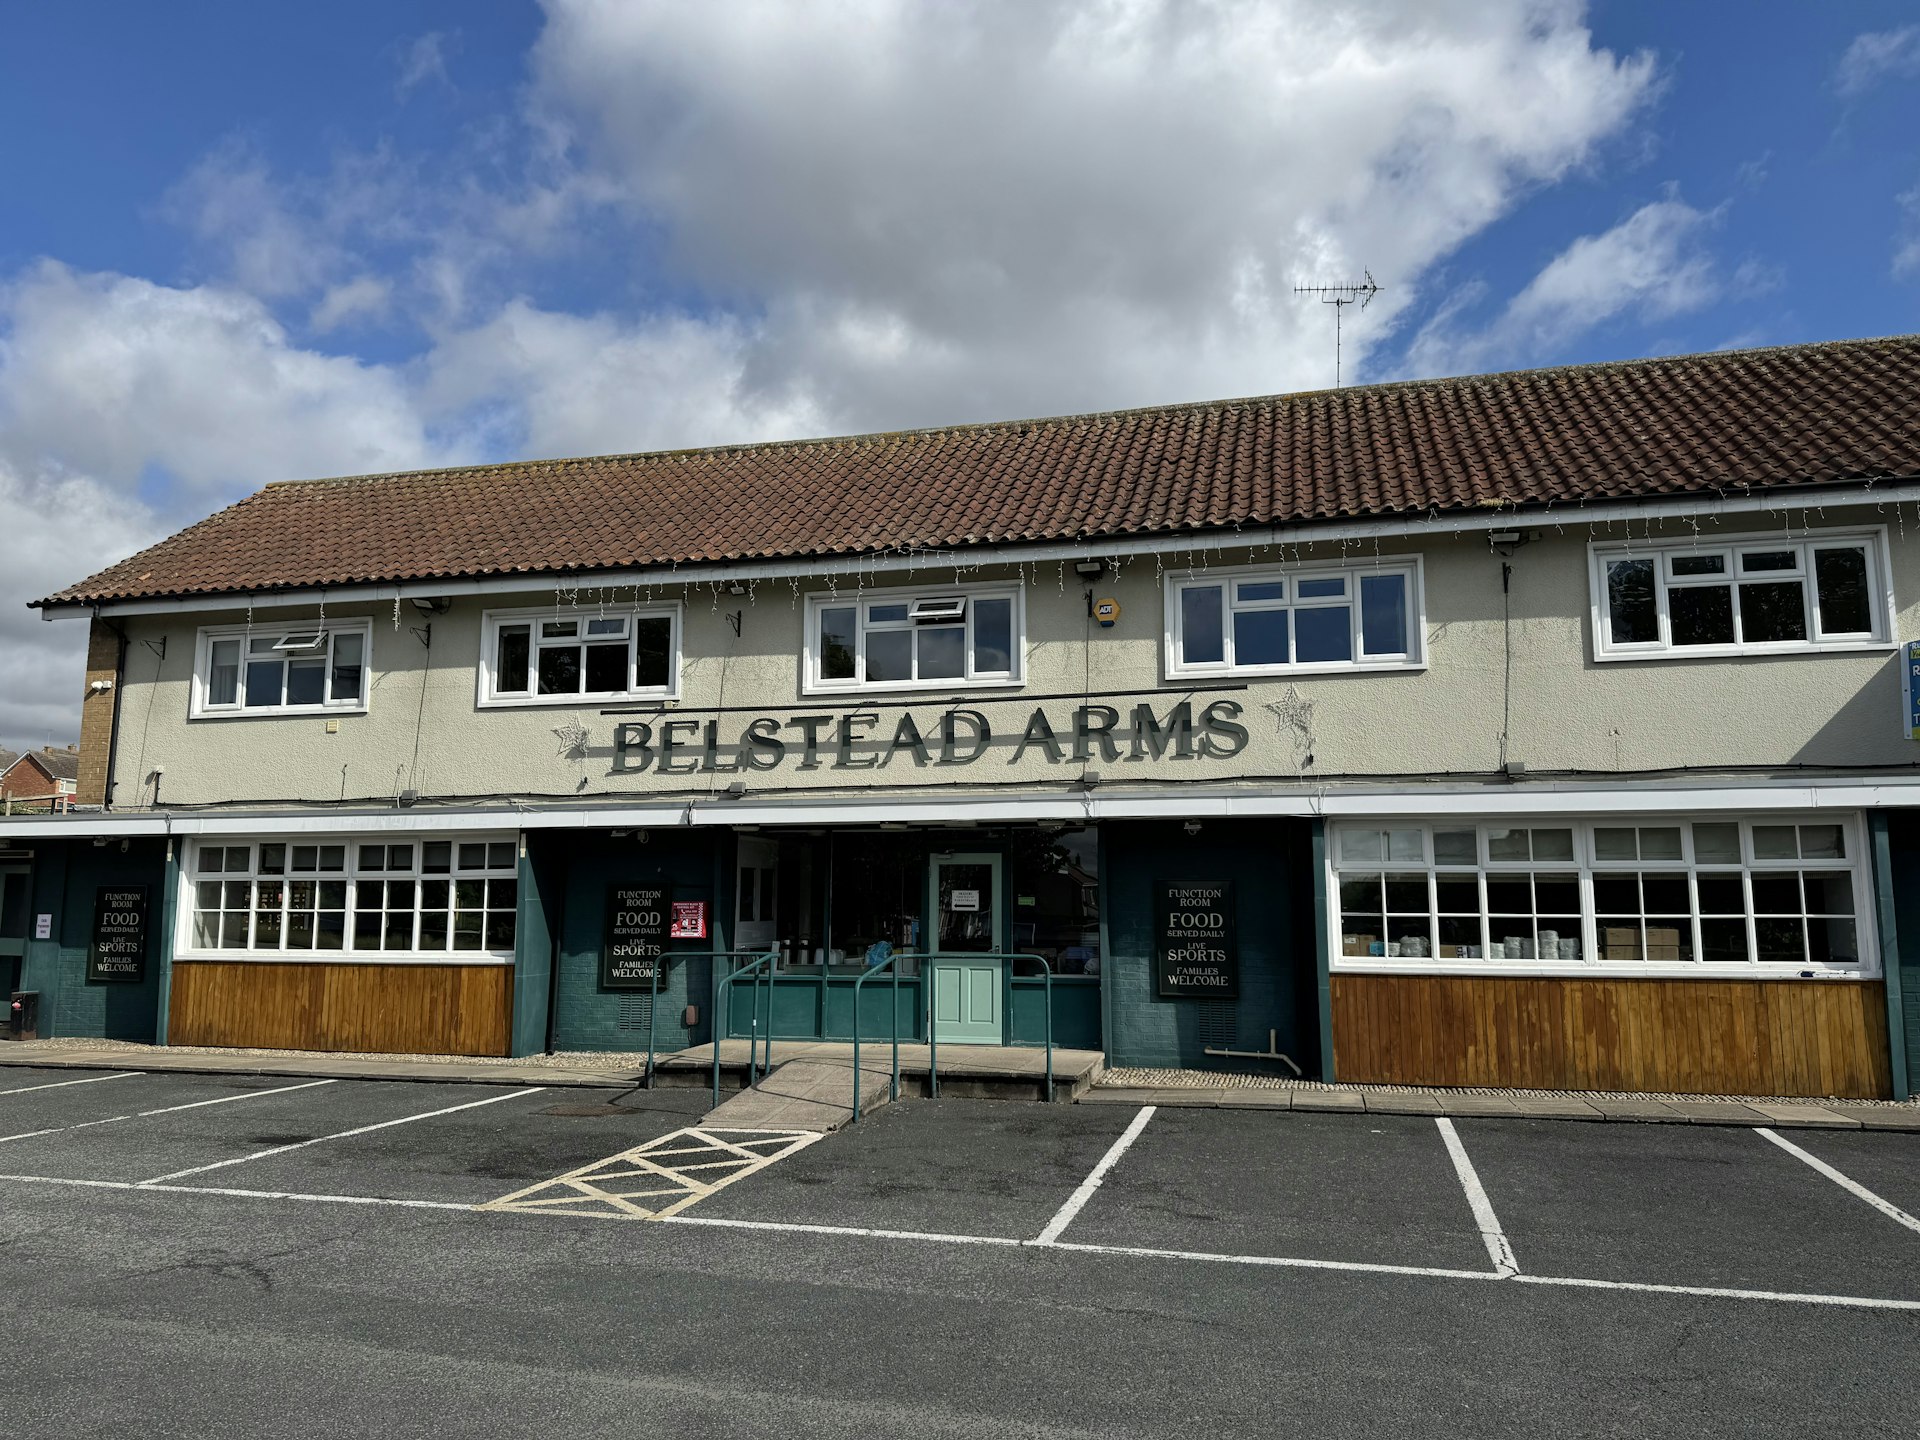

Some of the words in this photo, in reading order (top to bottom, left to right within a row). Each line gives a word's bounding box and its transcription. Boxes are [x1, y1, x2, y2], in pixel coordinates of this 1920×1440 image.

[1099, 605, 1113, 614] ADT
[609, 709, 992, 772] BELSTEAD
[1012, 700, 1249, 759] ARMS
[617, 890, 661, 899] FUNCTION
[1168, 889, 1222, 898] FUNCTION
[626, 899, 652, 907] ROOM
[1179, 898, 1211, 907] ROOM
[102, 912, 139, 925] FOOD
[615, 912, 661, 926] FOOD
[1168, 913, 1223, 928] FOOD
[99, 942, 137, 952] SPORTS
[613, 945, 661, 956] SPORTS
[1168, 949, 1226, 962] SPORTS
[97, 963, 137, 972] WELCOME
[1176, 967, 1219, 975] FAMILIES
[1168, 975, 1229, 986] WELCOME
